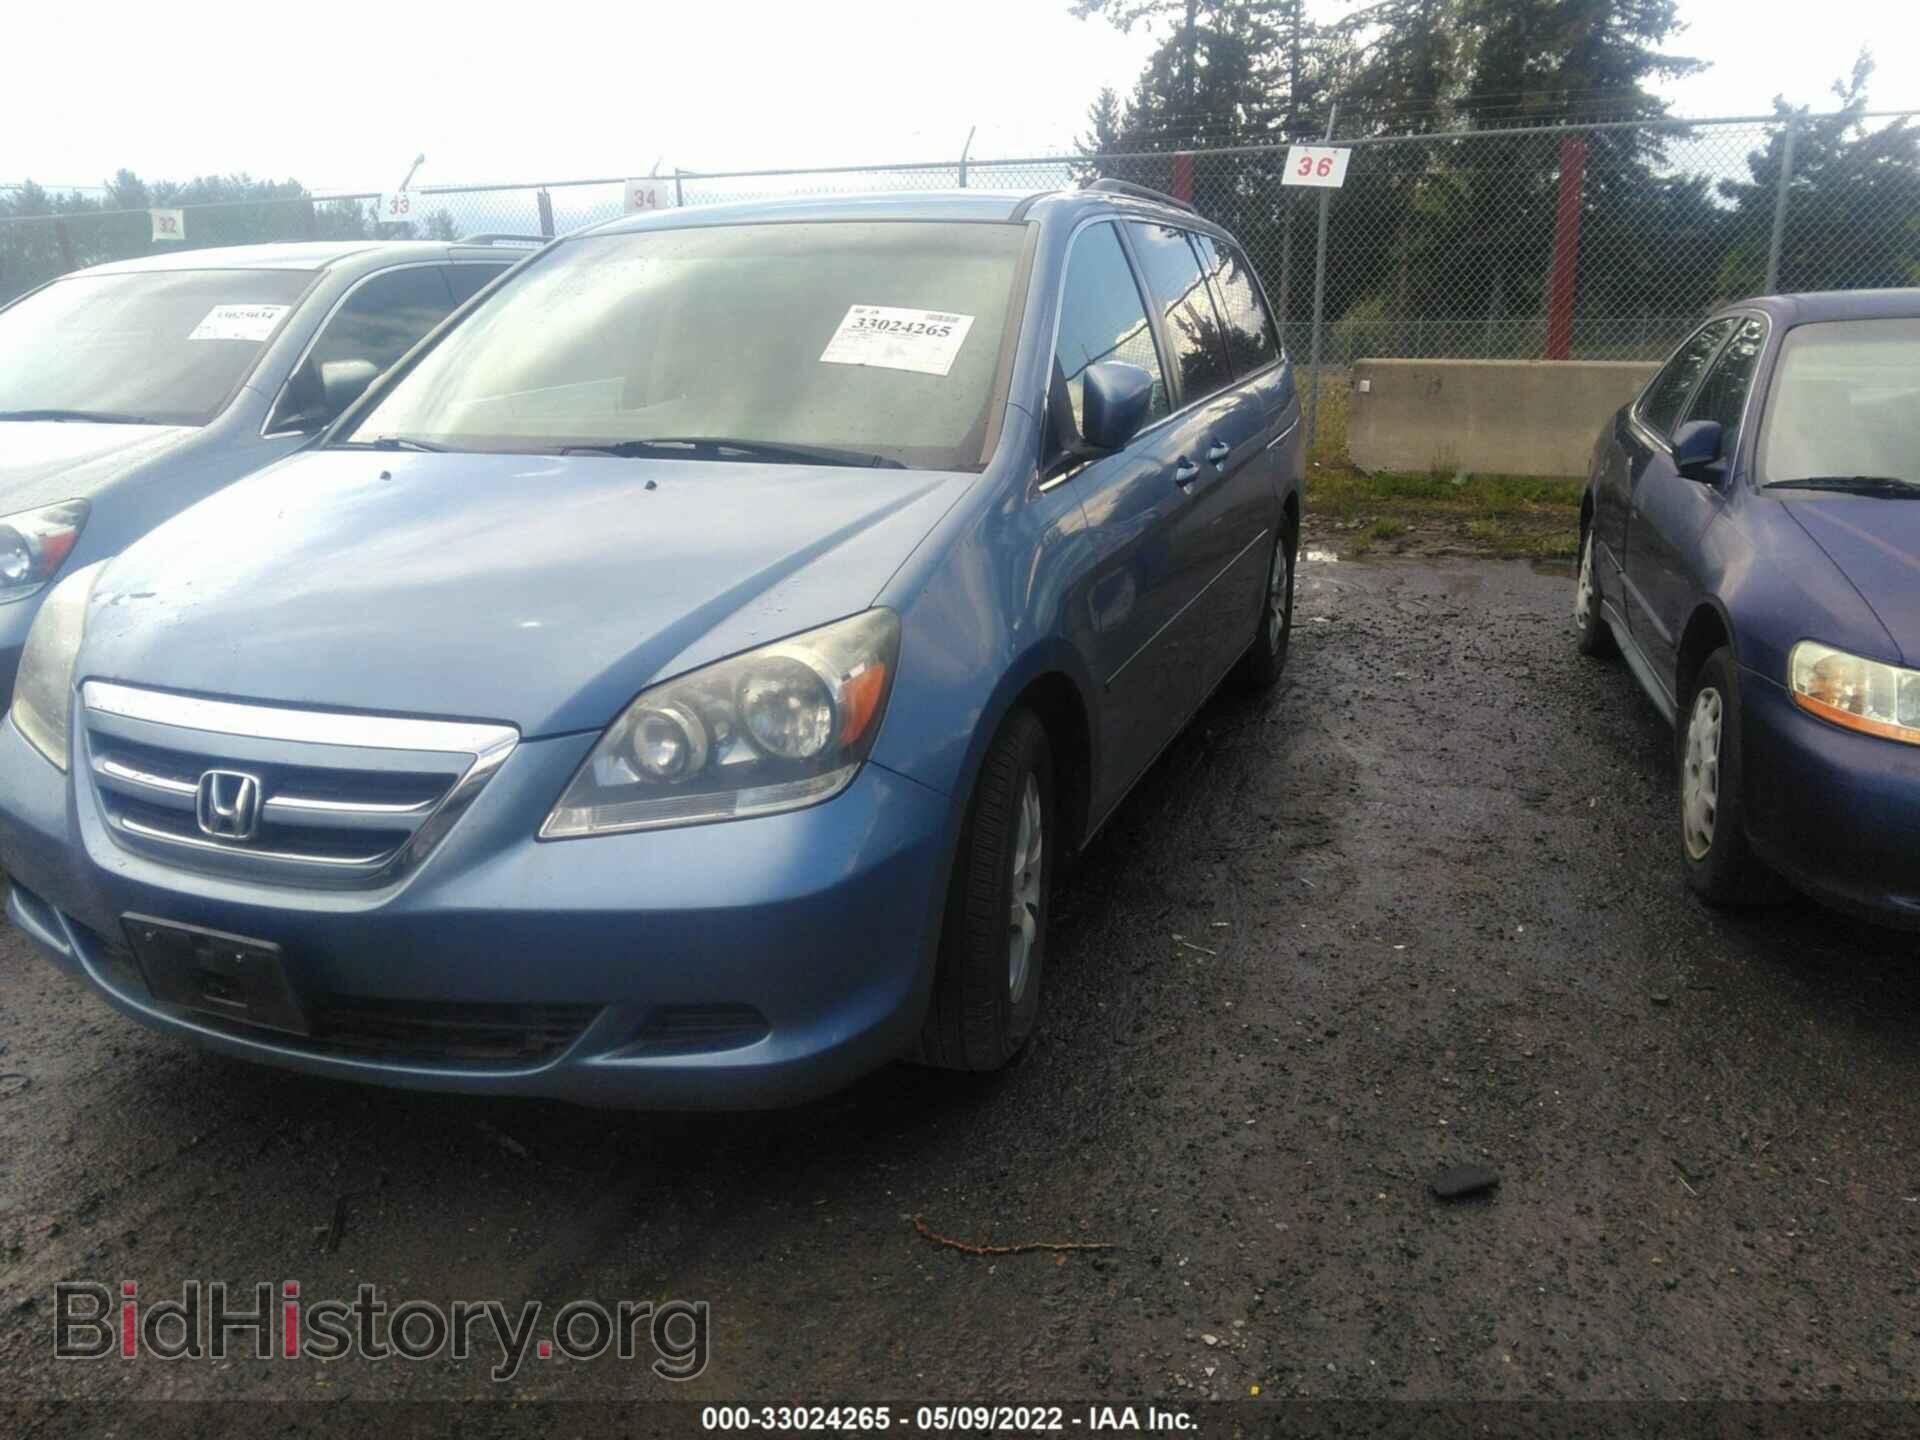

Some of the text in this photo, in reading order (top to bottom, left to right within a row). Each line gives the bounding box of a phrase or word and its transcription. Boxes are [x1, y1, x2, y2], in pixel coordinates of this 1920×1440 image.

[1297, 156, 1333, 177] 36
[389, 199, 410, 215] 33
[634, 189, 656, 208] 34
[159, 216, 177, 233] 32
[851, 316, 953, 338] 33024265
